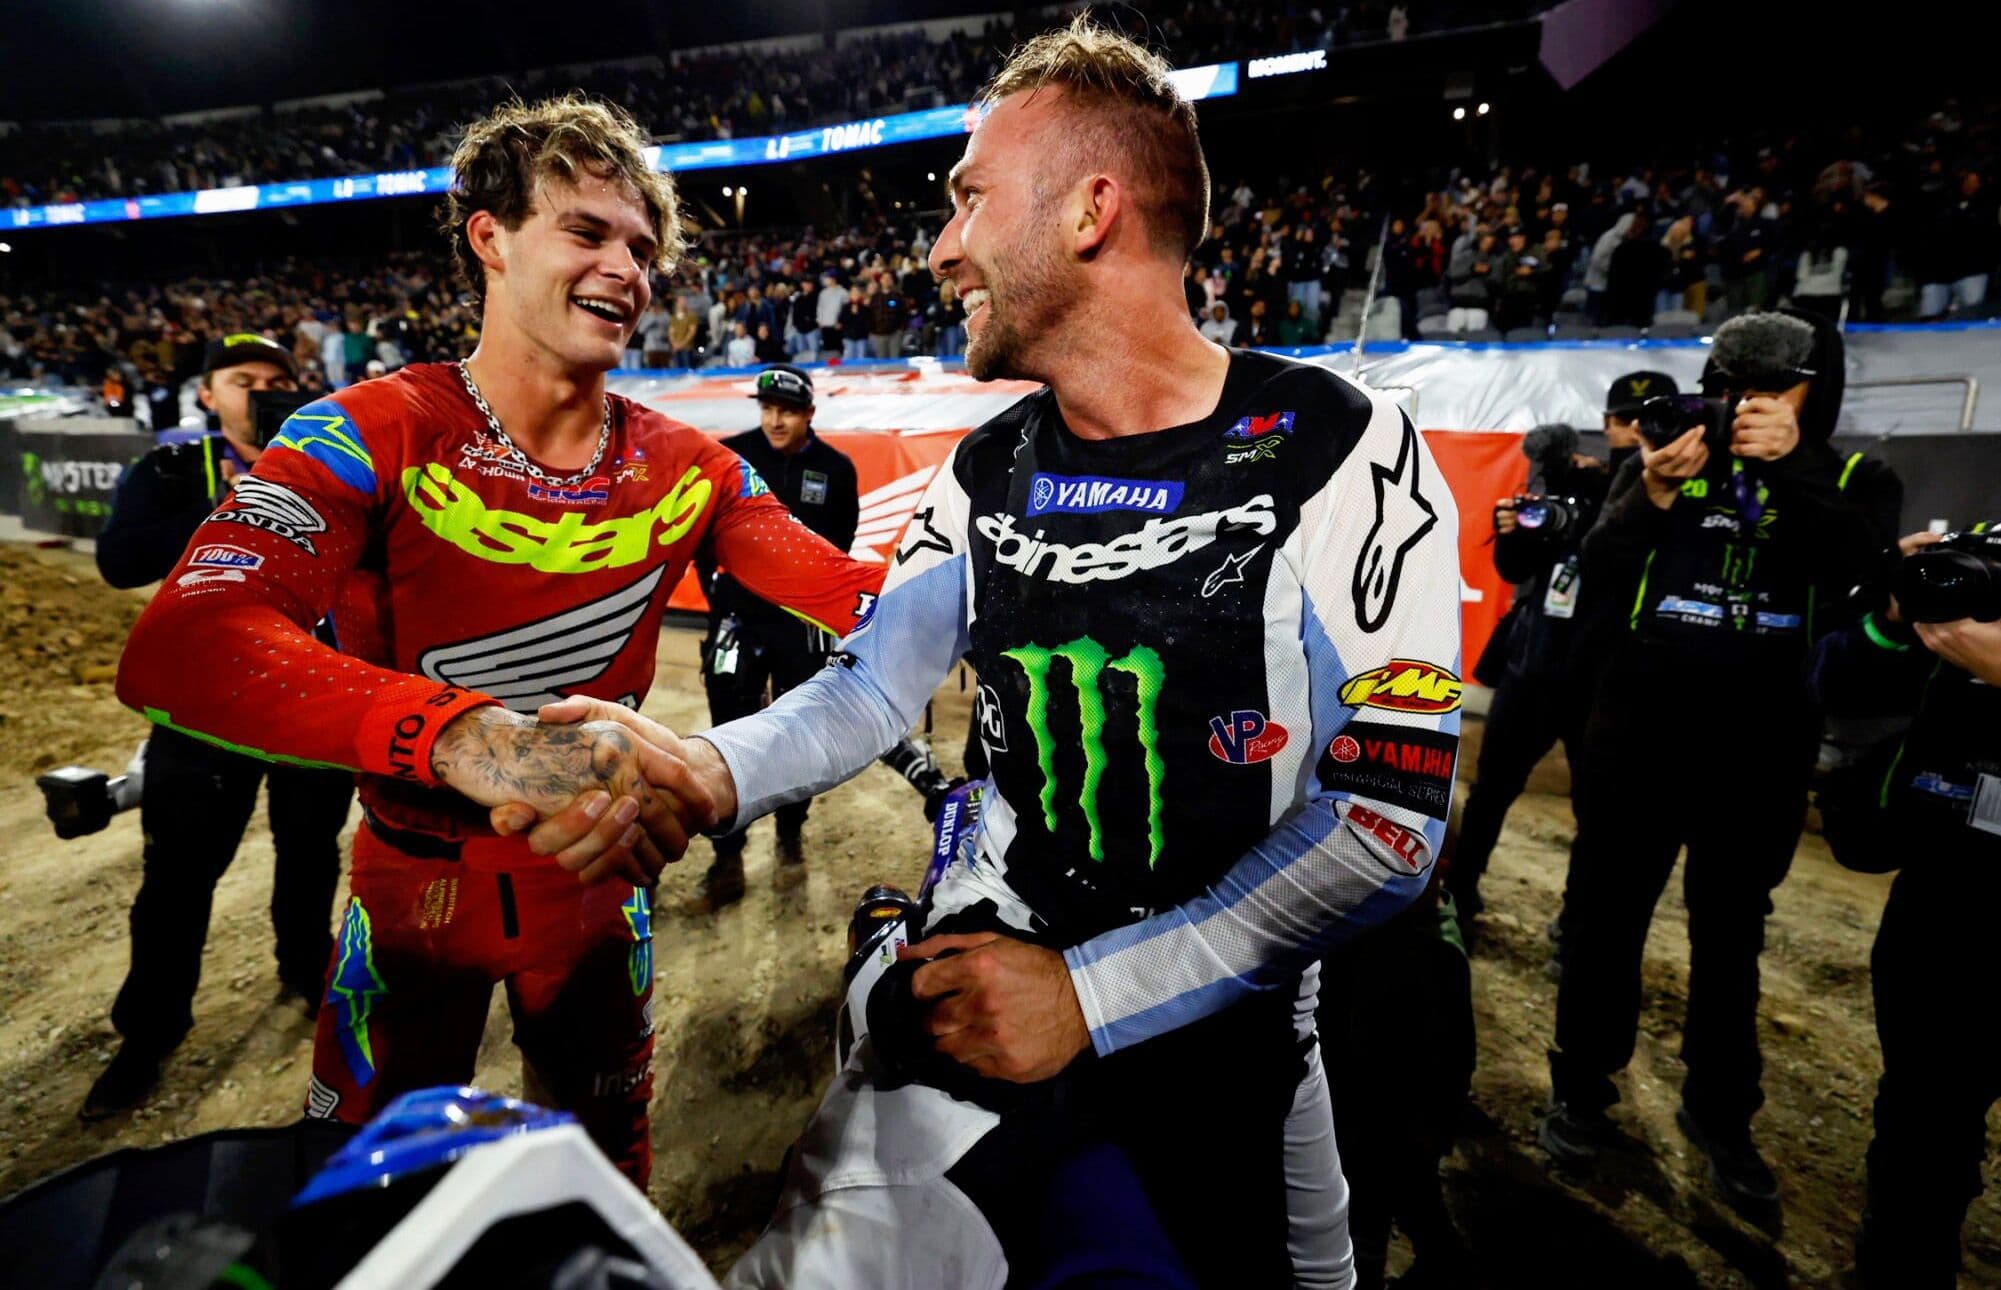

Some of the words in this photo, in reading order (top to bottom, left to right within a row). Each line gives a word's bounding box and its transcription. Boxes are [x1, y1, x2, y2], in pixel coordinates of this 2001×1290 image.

[821, 119, 886, 151] TOMAC
[1056, 481, 1169, 510] YAMAHA
[203, 511, 318, 556] ONDA
[198, 548, 253, 566] 100%
[1208, 710, 1266, 764] VP
[1365, 739, 1453, 780] YAMAHA
[938, 801, 959, 857] DUNLOP
[1347, 803, 1426, 870] BELL
